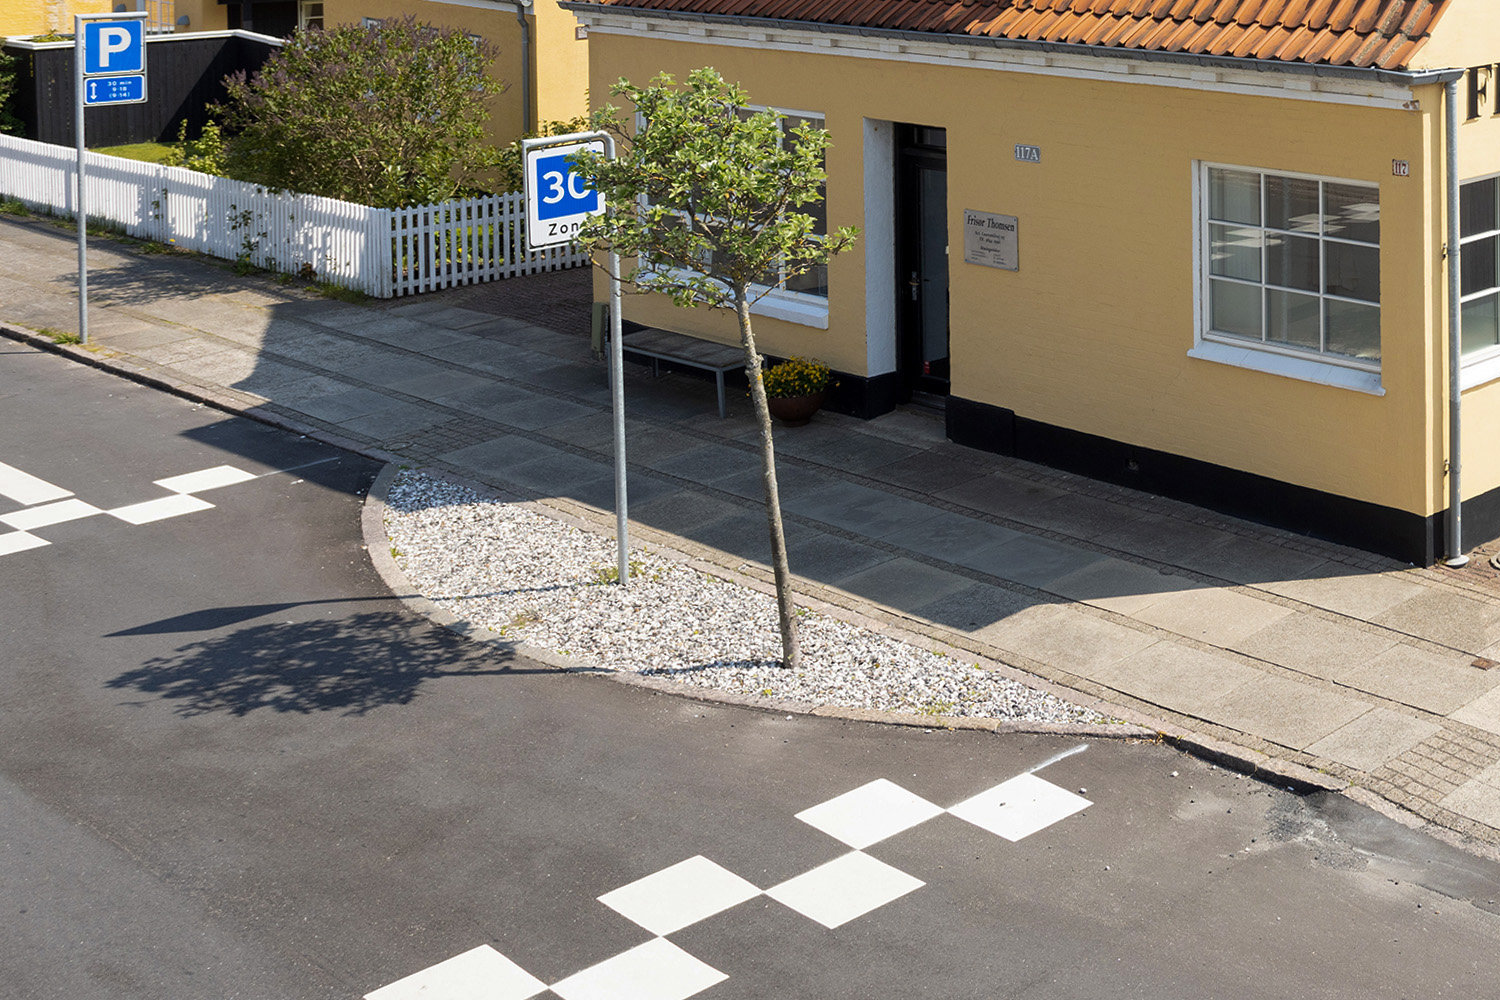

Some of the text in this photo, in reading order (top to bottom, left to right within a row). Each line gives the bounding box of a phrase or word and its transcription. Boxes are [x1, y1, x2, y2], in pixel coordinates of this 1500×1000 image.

[98, 27, 132, 68] P
[1016, 146, 1039, 161] 117A
[1395, 162, 1407, 175] 117
[542, 170, 593, 204] 30
[548, 222, 580, 236] Zon
[987, 217, 1015, 232] Thomsen
